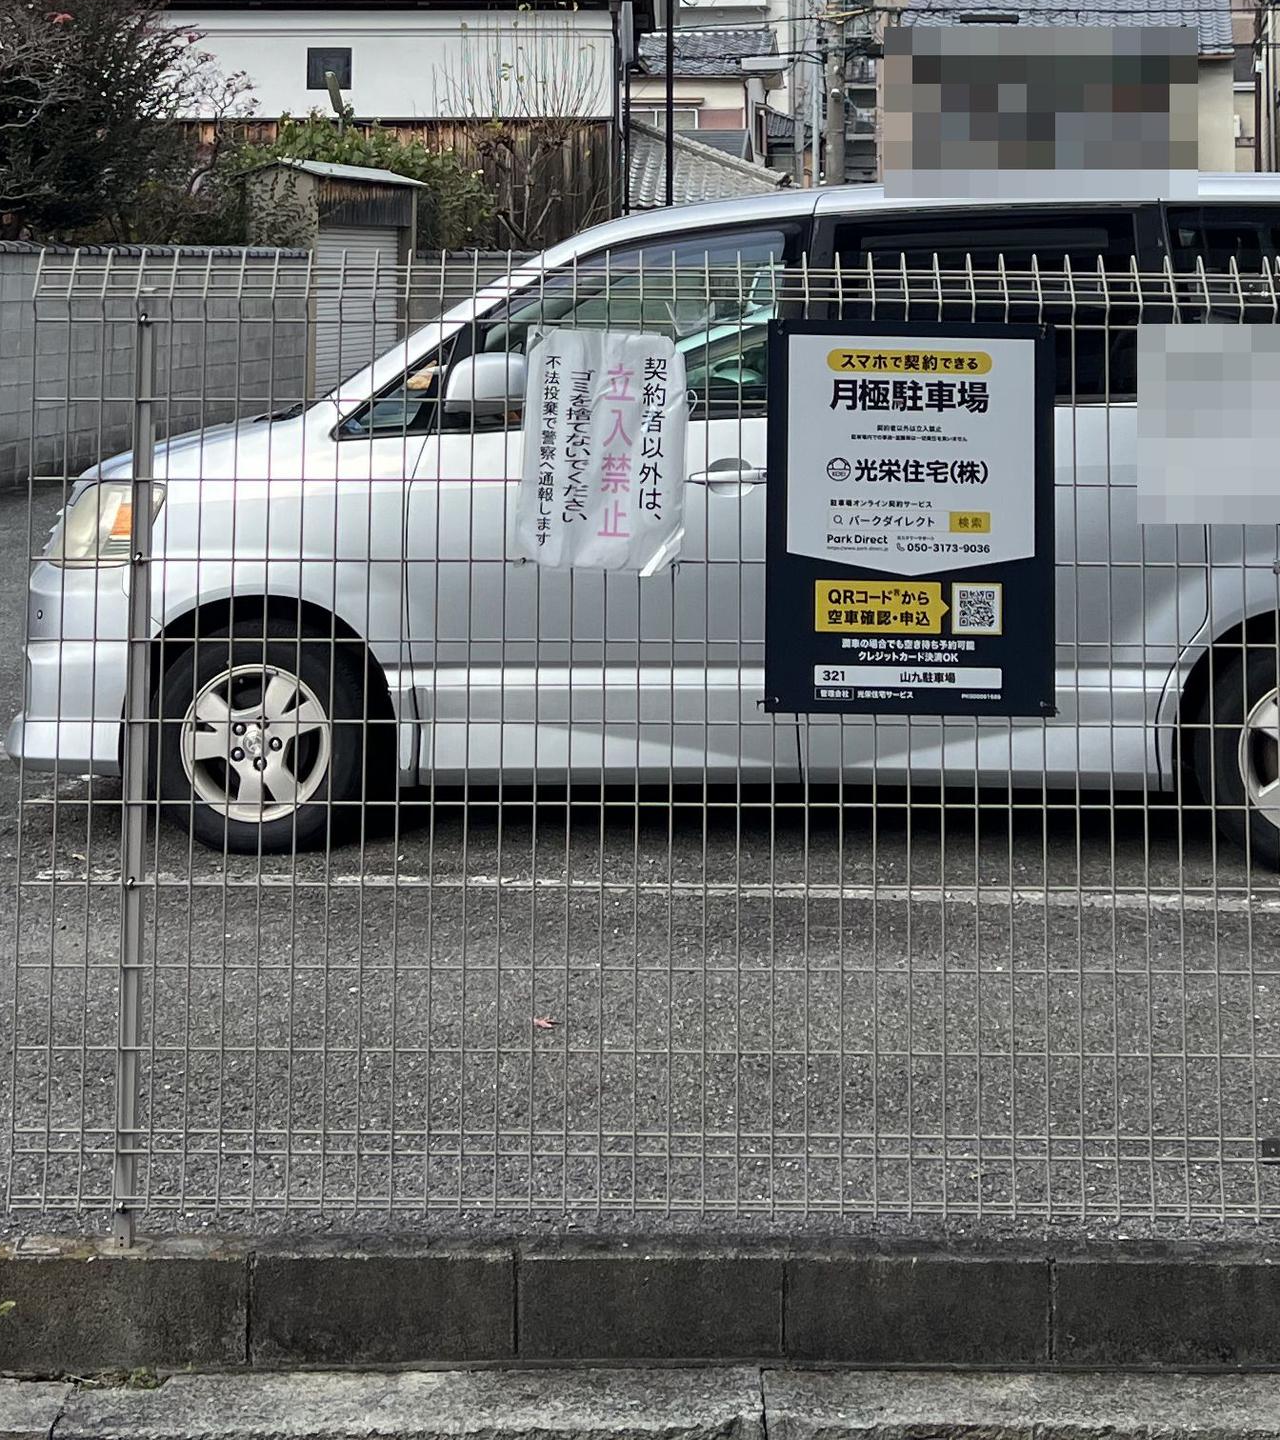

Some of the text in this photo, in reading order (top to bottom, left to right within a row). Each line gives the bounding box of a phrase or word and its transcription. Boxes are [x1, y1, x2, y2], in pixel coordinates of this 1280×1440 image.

[840, 354, 979, 371] スマホで契約できる
[830, 378, 990, 414] 月極駐車場
[638, 356, 668, 521] 契約者以外は、
[535, 355, 562, 546] 不法投棄で警察へ通報します
[562, 369, 596, 523] ゴミを捨てないでください
[597, 362, 636, 538] 立入禁止
[854, 458, 989, 485] 光栄住宅(株)
[830, 498, 933, 509] 駐車場オンライン契約サービス
[958, 516, 983, 530] 検索
[827, 533, 852, 544] Park
[854, 534, 888, 545] Direct
[907, 543, 991, 554] 050-3173-9036
[827, 610, 931, 627] 空車確認・申込
[841, 637, 976, 651] 満車の場合でも空き待ち予約可能
[858, 651, 959, 663] クレジットカード決済OK
[822, 670, 846, 682] 321
[899, 672, 956, 684] 山九駐車場
[820, 689, 850, 699] 管理会社
[857, 690, 914, 700] 光栄住宅サービス
